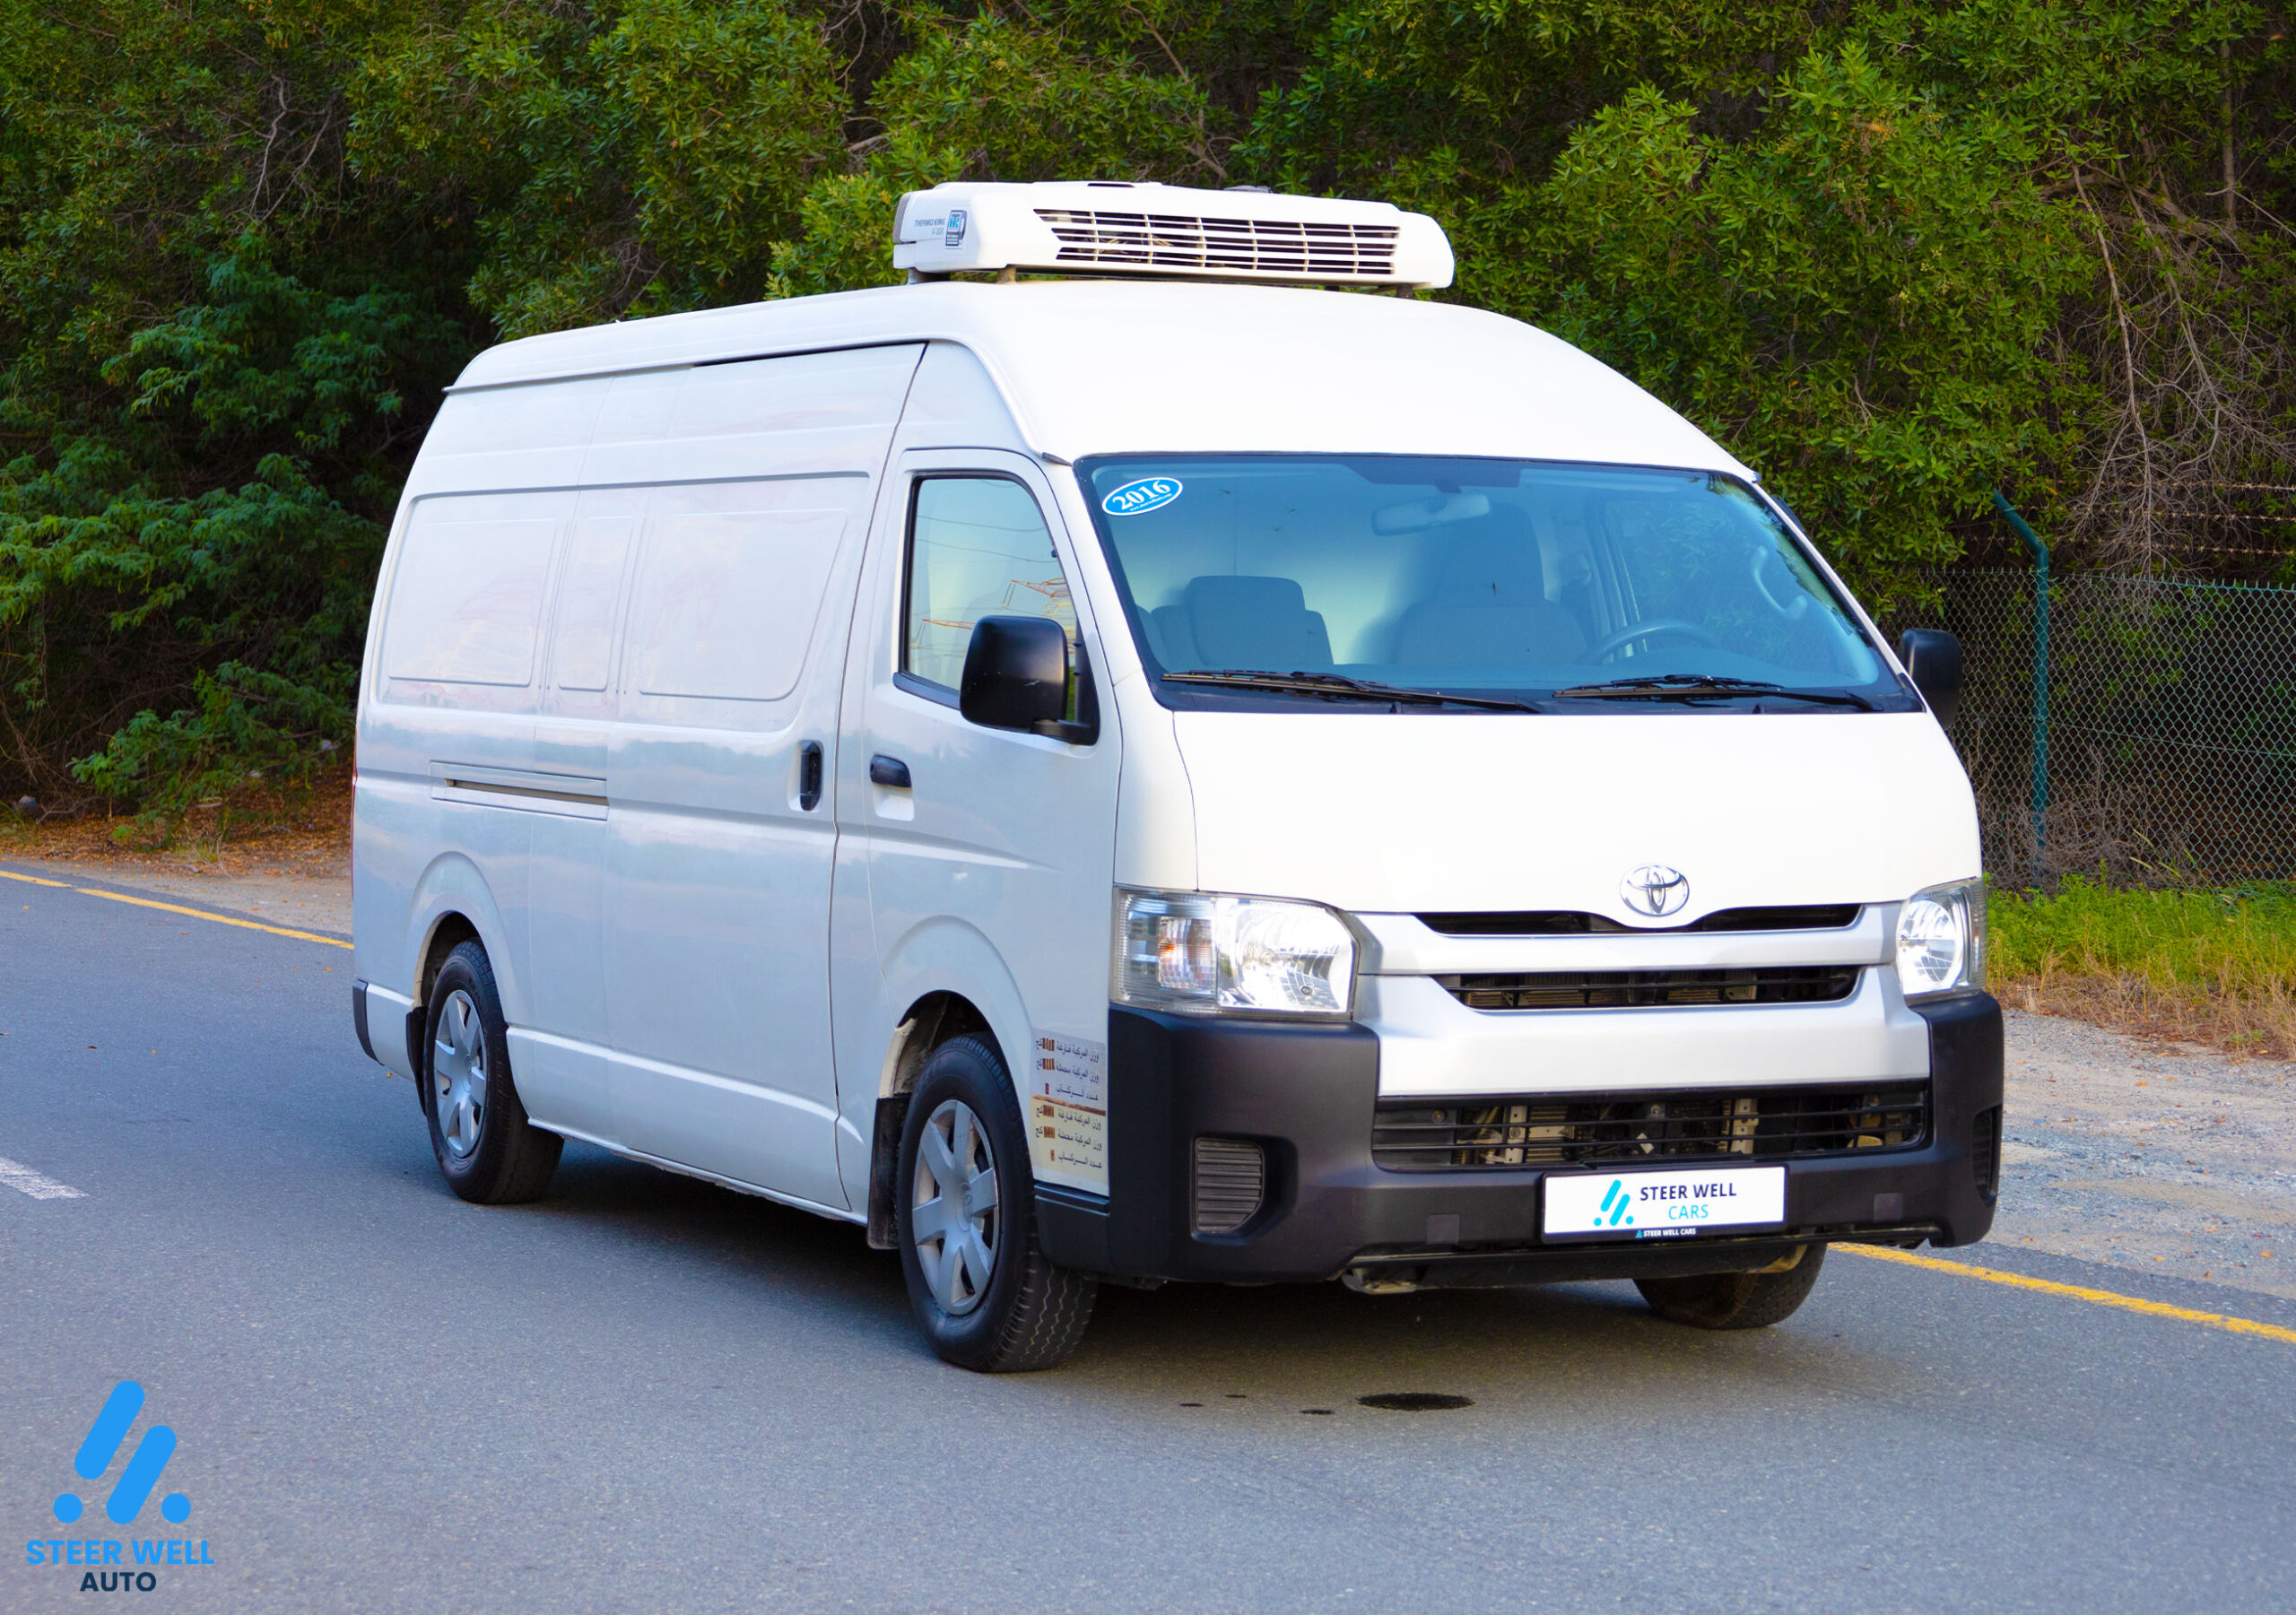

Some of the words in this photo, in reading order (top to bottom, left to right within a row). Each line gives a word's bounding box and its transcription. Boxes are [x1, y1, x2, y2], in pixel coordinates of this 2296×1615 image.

[934, 218, 945, 226] KING
[1112, 480, 1171, 510] 2016
[1639, 1185, 1688, 1201] STEER
[1693, 1183, 1736, 1198] WELL
[1668, 1203, 1709, 1220] CARS
[1643, 1229, 1662, 1237] STEER
[1663, 1229, 1679, 1237] WELL
[1680, 1228, 1697, 1236] CARS
